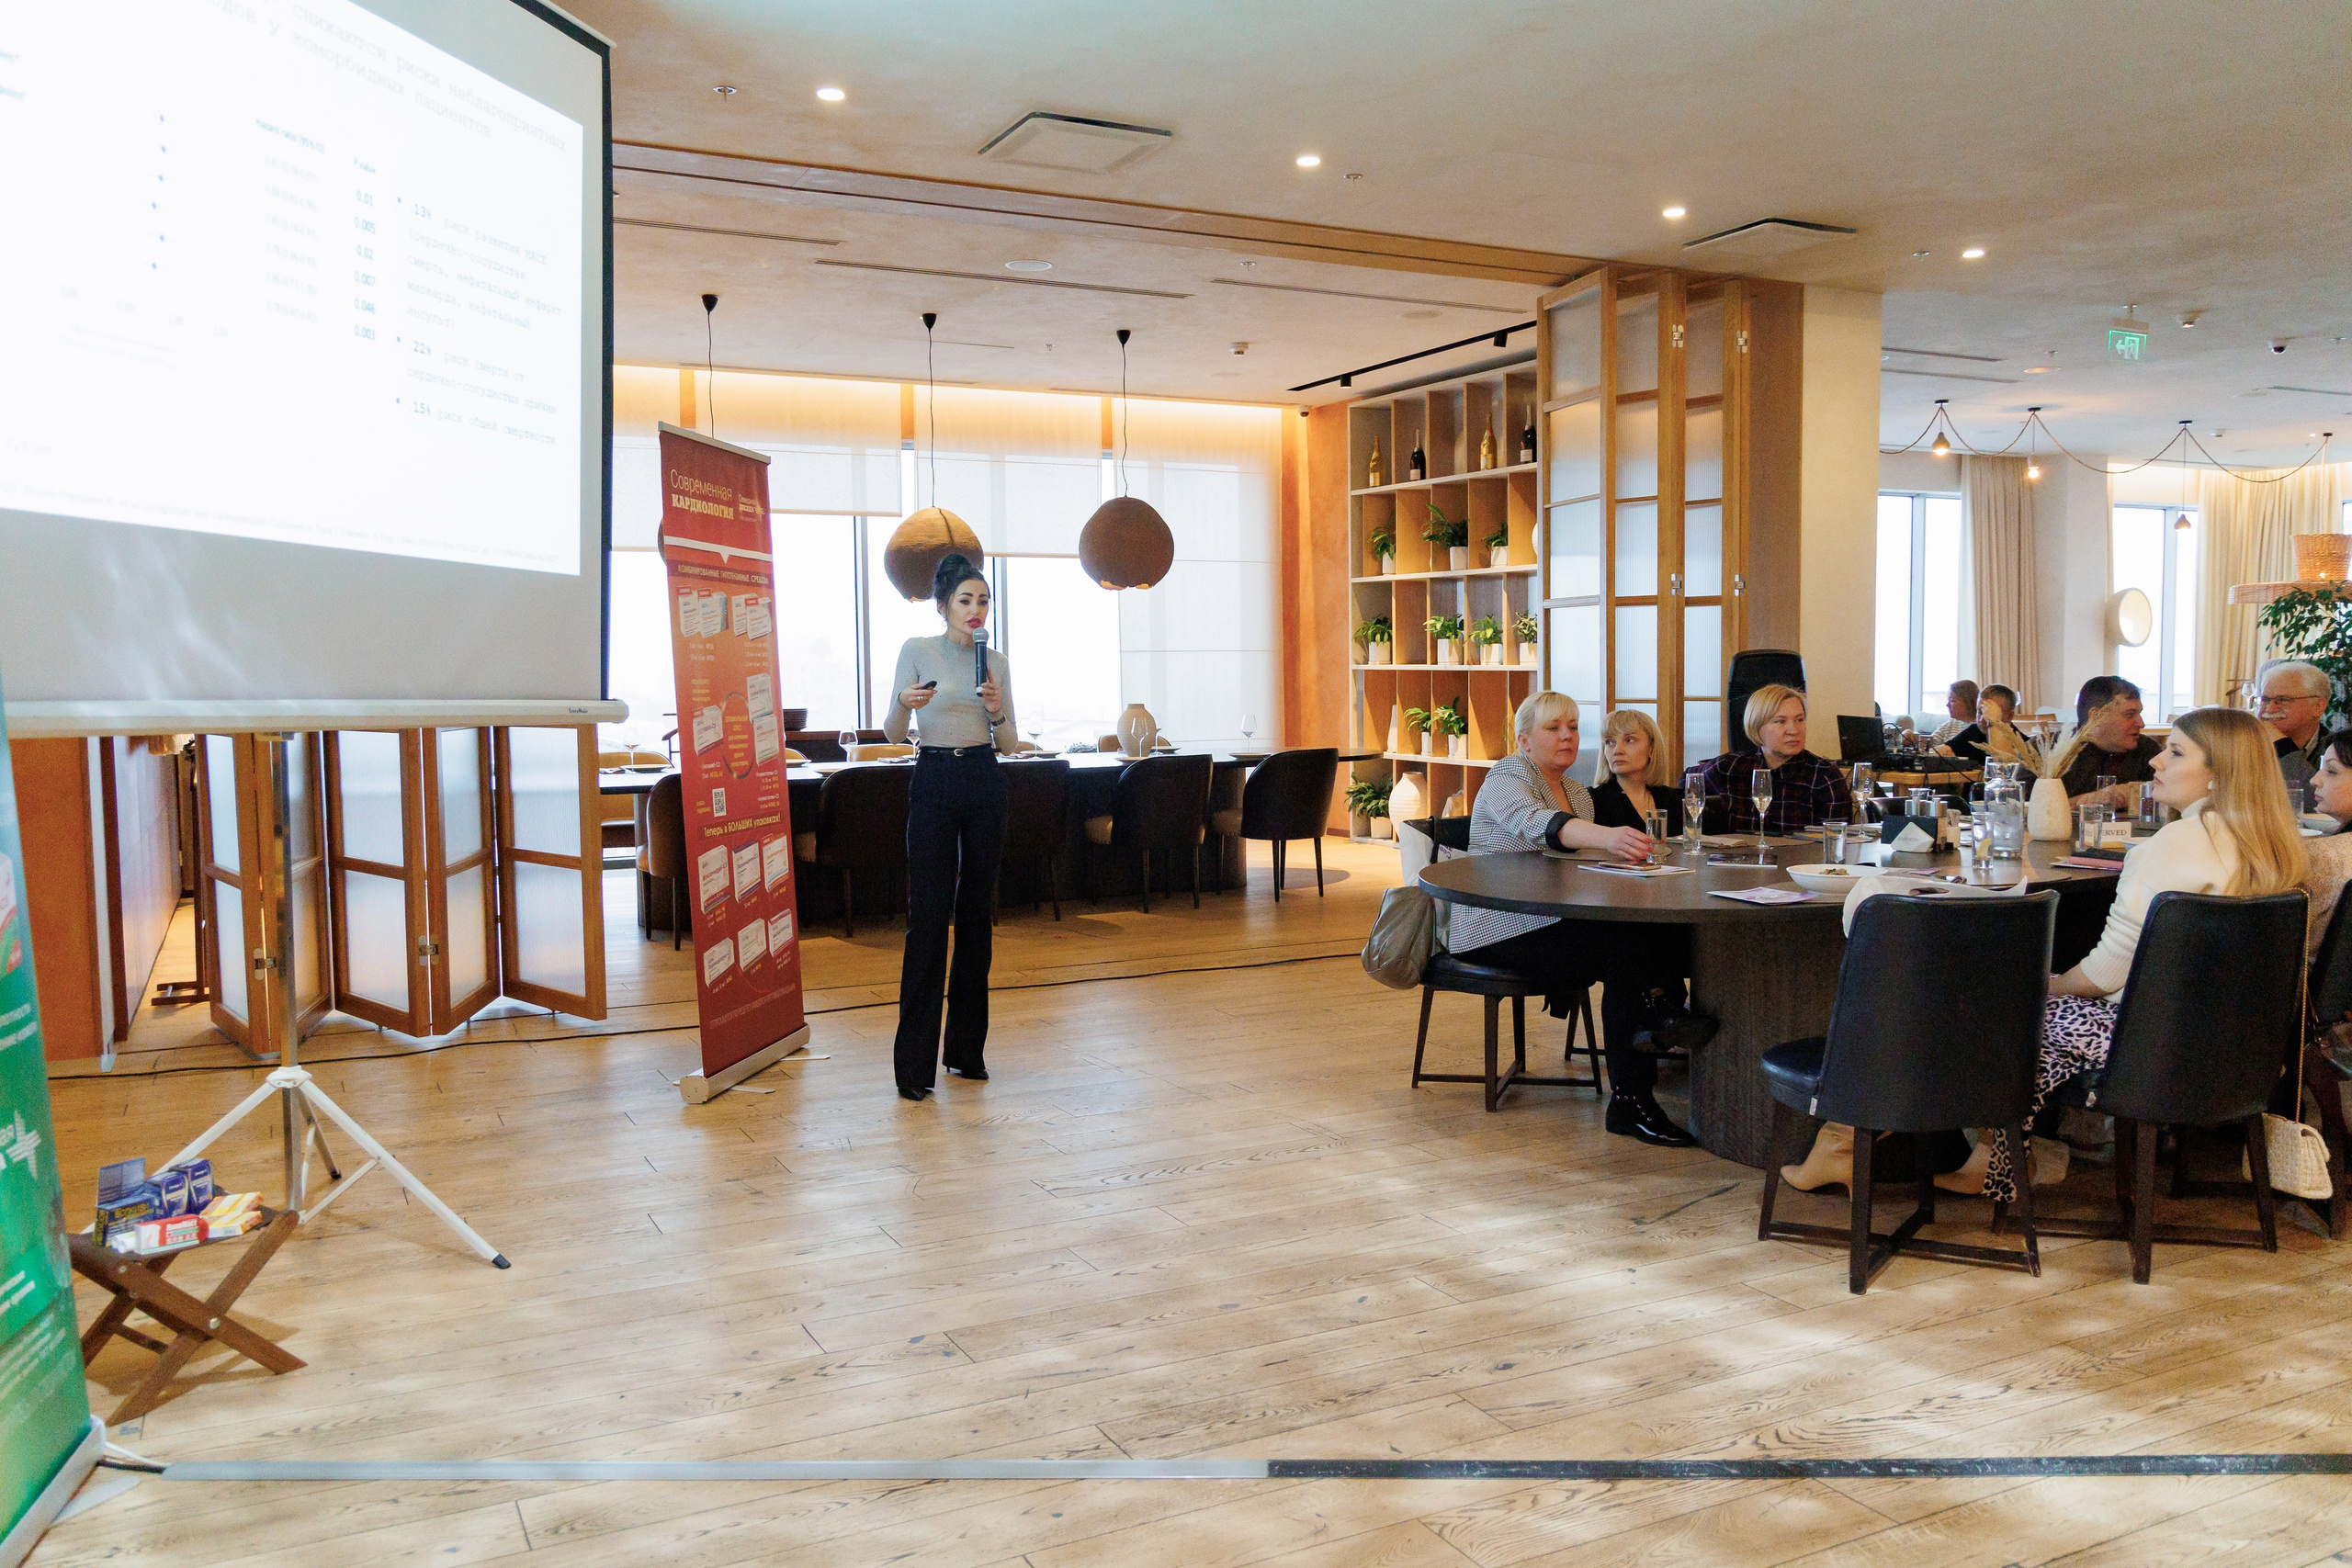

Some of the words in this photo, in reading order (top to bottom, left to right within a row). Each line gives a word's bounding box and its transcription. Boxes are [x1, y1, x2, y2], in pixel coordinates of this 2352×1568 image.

[293, 5, 387, 62] снижаются
[396, 56, 440, 88] риски
[448, 85, 565, 151] неблагоприятных
[294, 32, 405, 97] коморбидных
[414, 92, 492, 138] пациентов
[356, 189, 373, 207] 0.01
[354, 216, 376, 234] 0.005
[444, 218, 469, 236] риск
[474, 230, 521, 255] развития
[356, 243, 373, 261] 0.02
[410, 228, 526, 280] (сердечно-сосудистая
[354, 270, 376, 287] 0.007
[407, 255, 449, 278] смерть,
[456, 272, 520, 301] нефатальный
[354, 297, 376, 314] 0.046
[406, 280, 461, 308] миокарда,
[469, 301, 531, 330] нефатальный
[407, 306, 455, 330] инсульт)
[354, 324, 376, 341] 0.003
[443, 351, 469, 367] риск
[474, 361, 509, 378] смерти
[514, 371, 526, 382] от
[407, 367, 519, 405] сердечно-сосудистых
[524, 396, 556, 414] причин
[437, 409, 462, 424] риск
[469, 416, 498, 432] общей
[503, 424, 556, 445] смертности
[671, 468, 732, 502] Современная
[672, 493, 734, 520] КАРДИОЛОГИЯ
[678, 565, 719, 578] КОМБИНИРОВАННЫЕ
[704, 827, 723, 838] Теперь
[728, 818, 752, 832] БОЛЬШИХ
[753, 812, 781, 829] упаковках!
